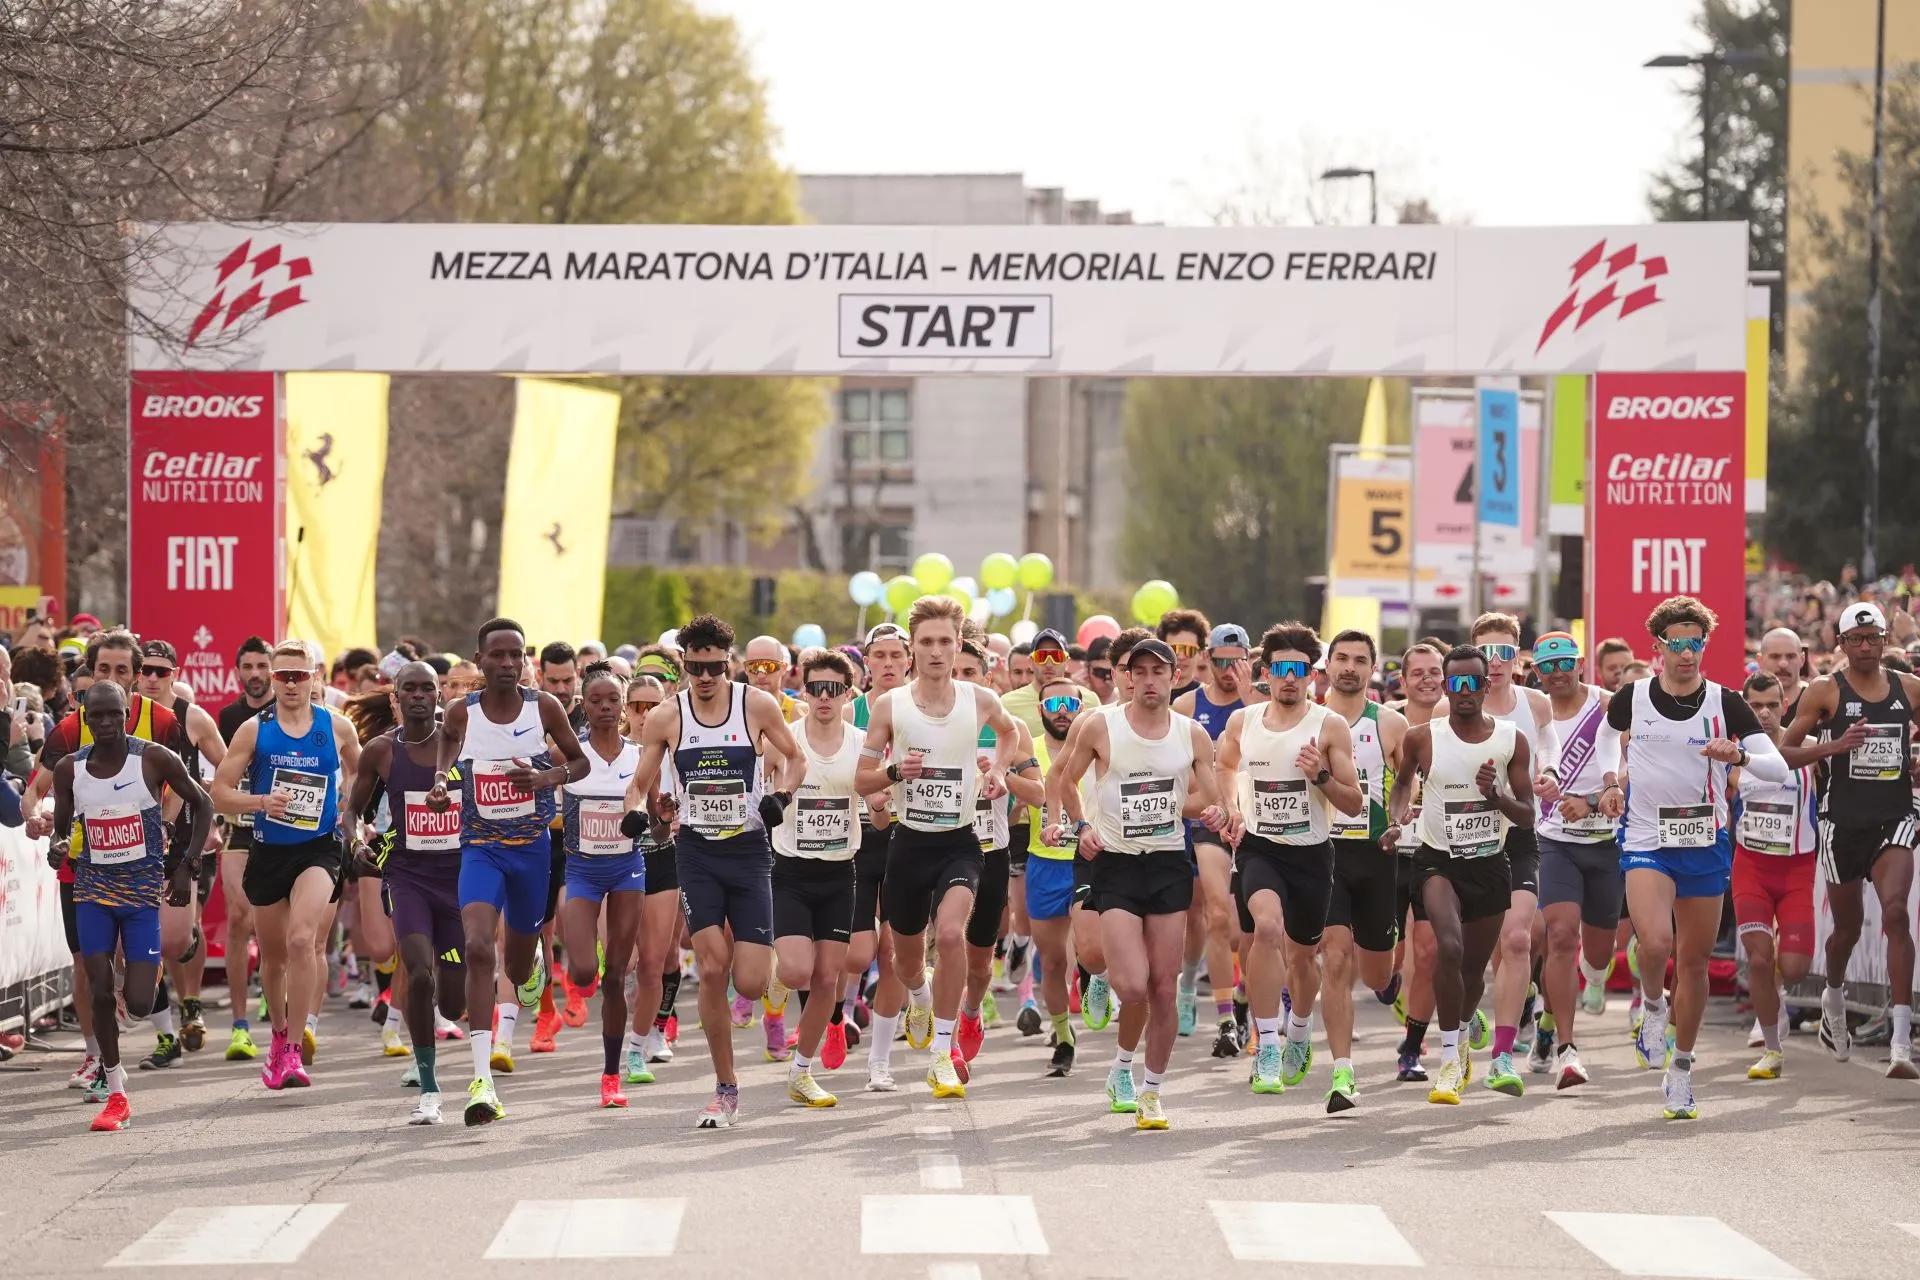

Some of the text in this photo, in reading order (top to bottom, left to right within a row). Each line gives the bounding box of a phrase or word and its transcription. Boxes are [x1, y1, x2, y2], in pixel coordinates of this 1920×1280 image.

[430, 251, 552, 280] MEZZA
[564, 251, 772, 280] MARATONA
[968, 252, 1165, 280] MEMORIAL
[1176, 252, 1275, 280] ENZO
[1284, 252, 1437, 280] FERRARI
[856, 304, 1035, 348] START
[142, 395, 264, 418] BROOKS
[1606, 395, 1735, 420] BROOKS
[143, 451, 262, 479] Cetilar
[1607, 452, 1732, 481] Cetilar
[143, 481, 263, 503] NUTRITION
[1607, 482, 1732, 505] NUTRITION
[1370, 508, 1403, 556] 5
[167, 536, 239, 591] FIAT
[1631, 537, 1707, 594] FIAT
[184, 651, 224, 667] ACQUA
[1863, 741, 1894, 754] 7253
[270, 754, 319, 768] SEMPREDICORSA
[916, 784, 952, 798] 4875
[491, 805, 520, 814] BROOKS
[701, 799, 733, 812] 3461
[924, 799, 944, 809] THOMAS
[1133, 796, 1168, 813] 4979
[1263, 796, 1298, 811] 4872
[408, 809, 460, 833] KIPRUTO
[807, 814, 841, 827] 4874
[908, 811, 935, 821] BROOKS
[1139, 812, 1163, 823] GIUSEPPE
[1455, 815, 1491, 831] 4870
[1753, 816, 1782, 830] 1799
[87, 821, 142, 847] KIPLANGAT
[1126, 827, 1154, 836] BROOKS
[1259, 825, 1284, 833] BROOKS
[1669, 821, 1705, 836] 5005
[420, 837, 448, 845] BROOKS
[799, 842, 826, 850] BROOKS
[1745, 839, 1768, 848] BROOKS
[103, 850, 131, 859] BROOKS
